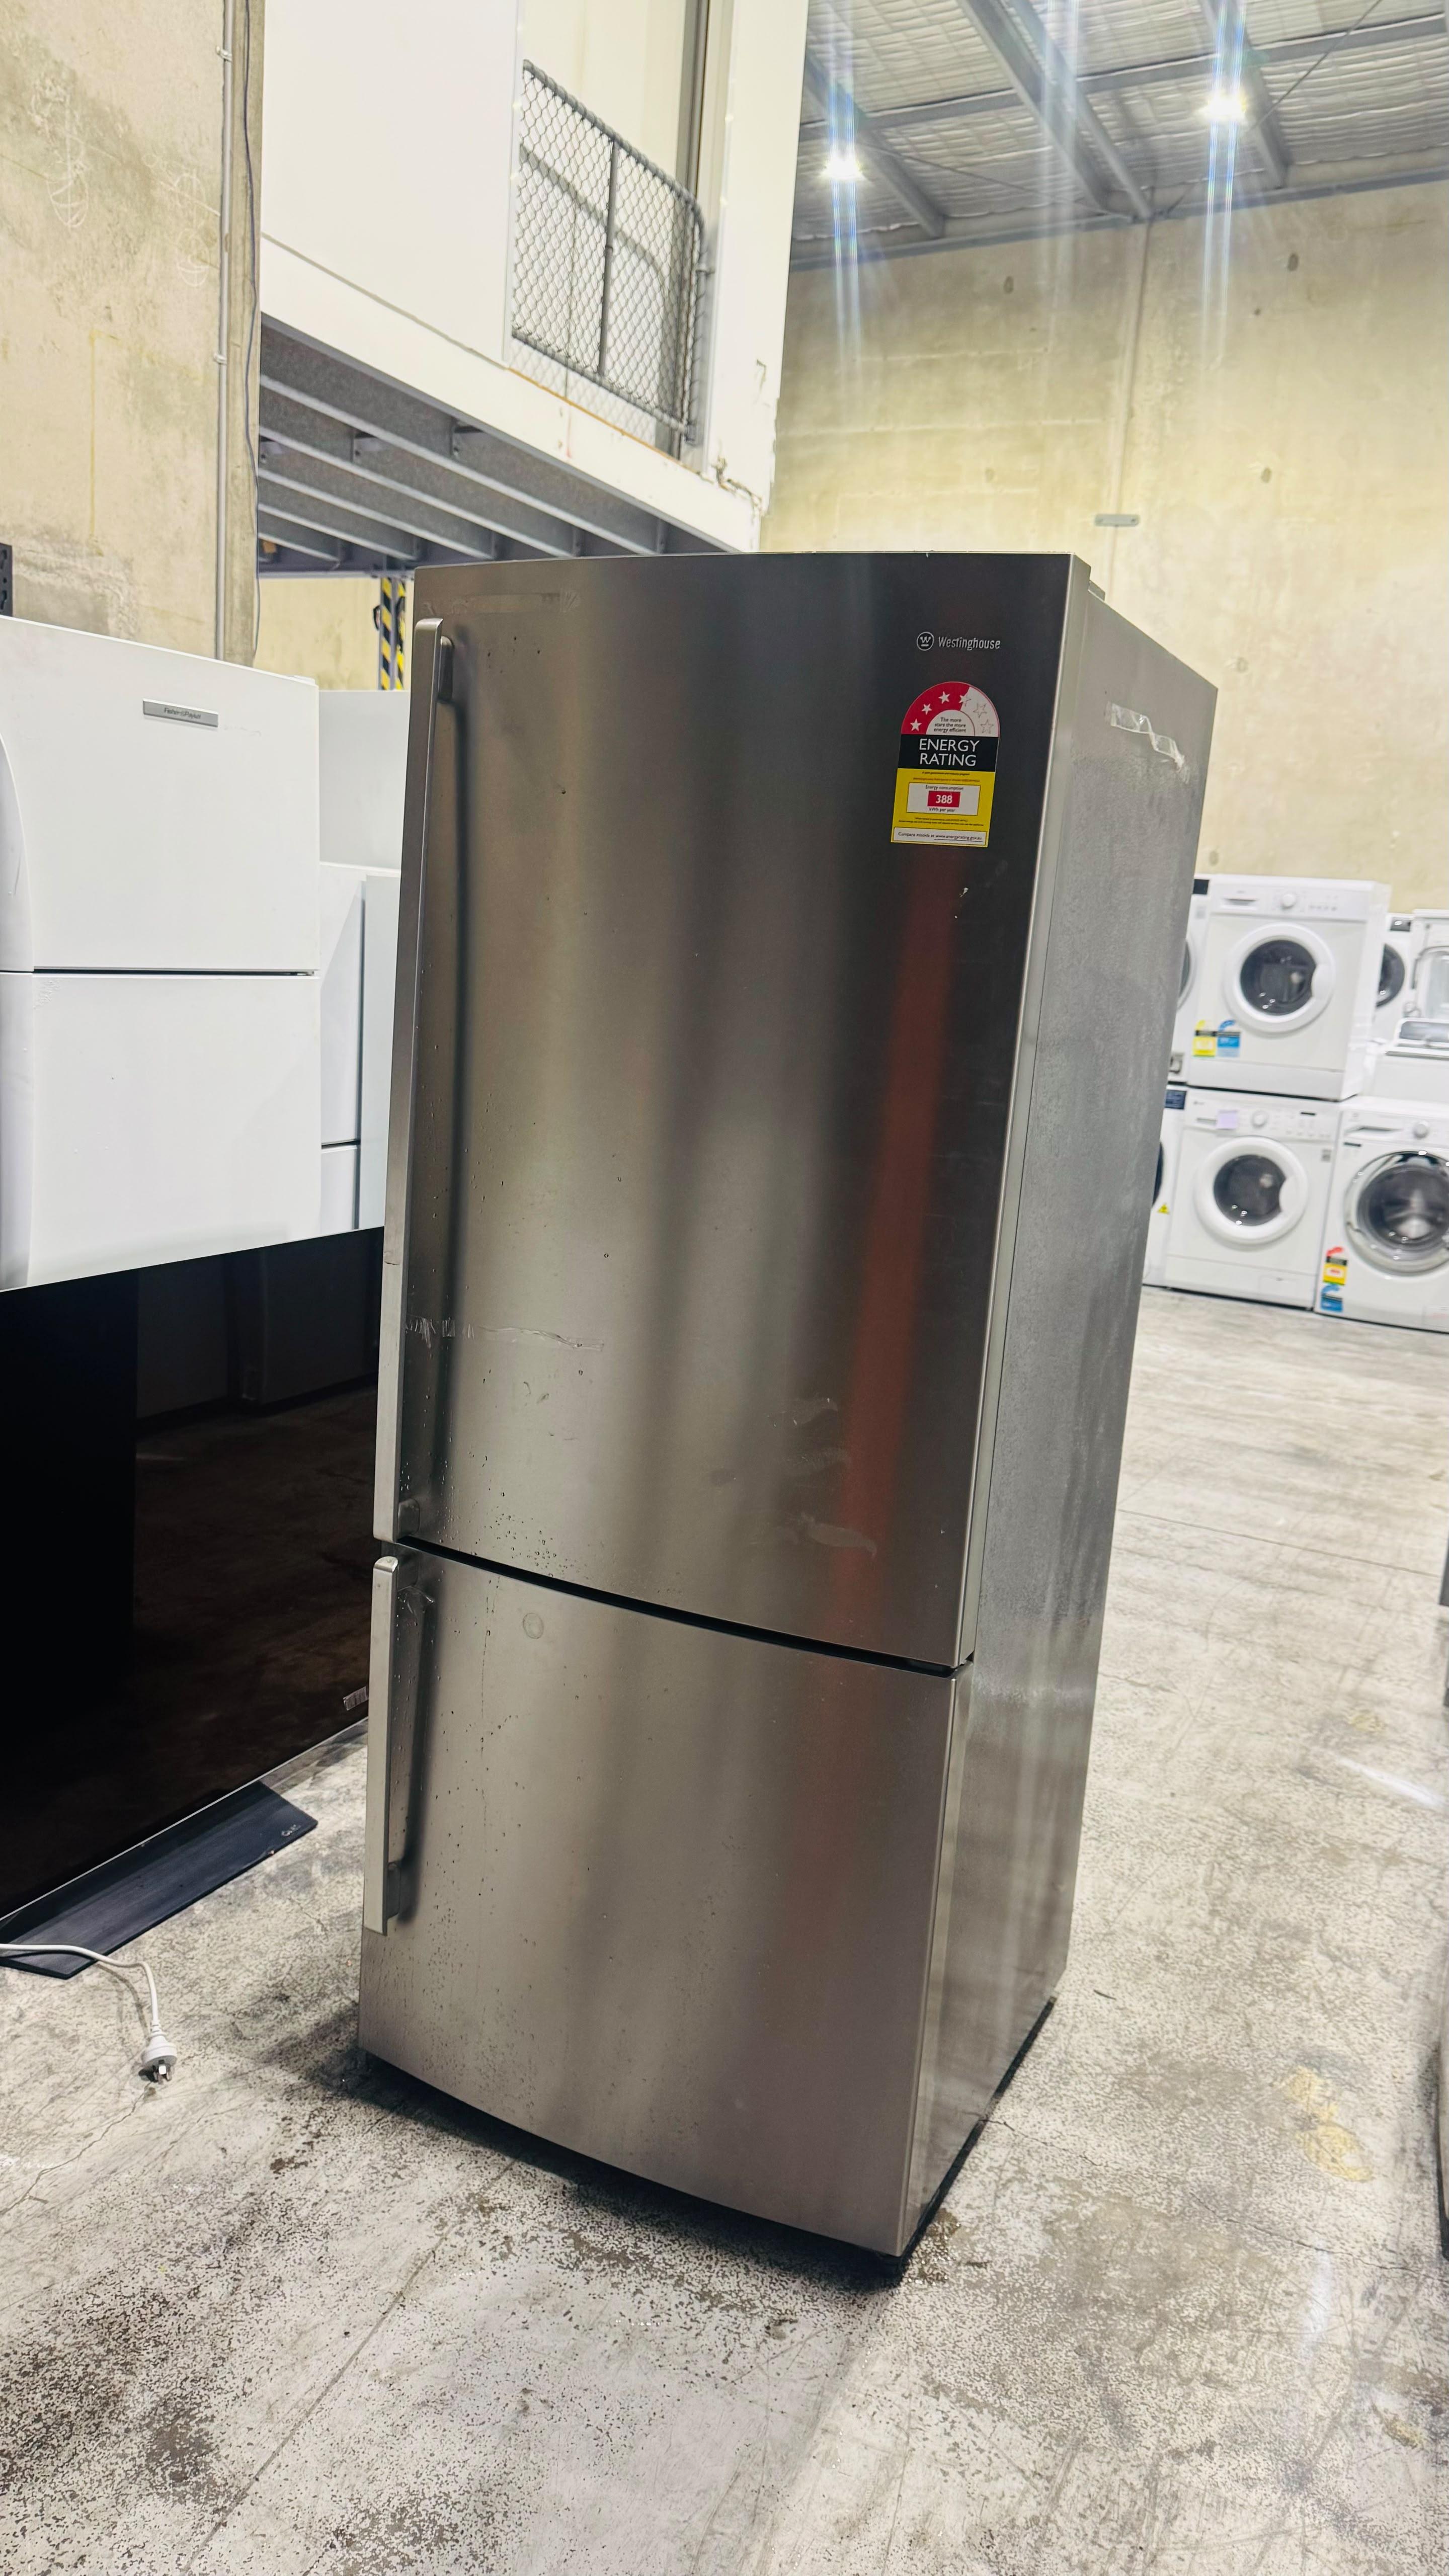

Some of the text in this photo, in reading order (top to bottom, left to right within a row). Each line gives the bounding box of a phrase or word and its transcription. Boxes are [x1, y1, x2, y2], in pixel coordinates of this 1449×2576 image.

[938, 636, 1001, 651] Westinghouse
[919, 738, 980, 752] ENERGY
[920, 753, 977, 767] RATING
[935, 794, 952, 804] 388
